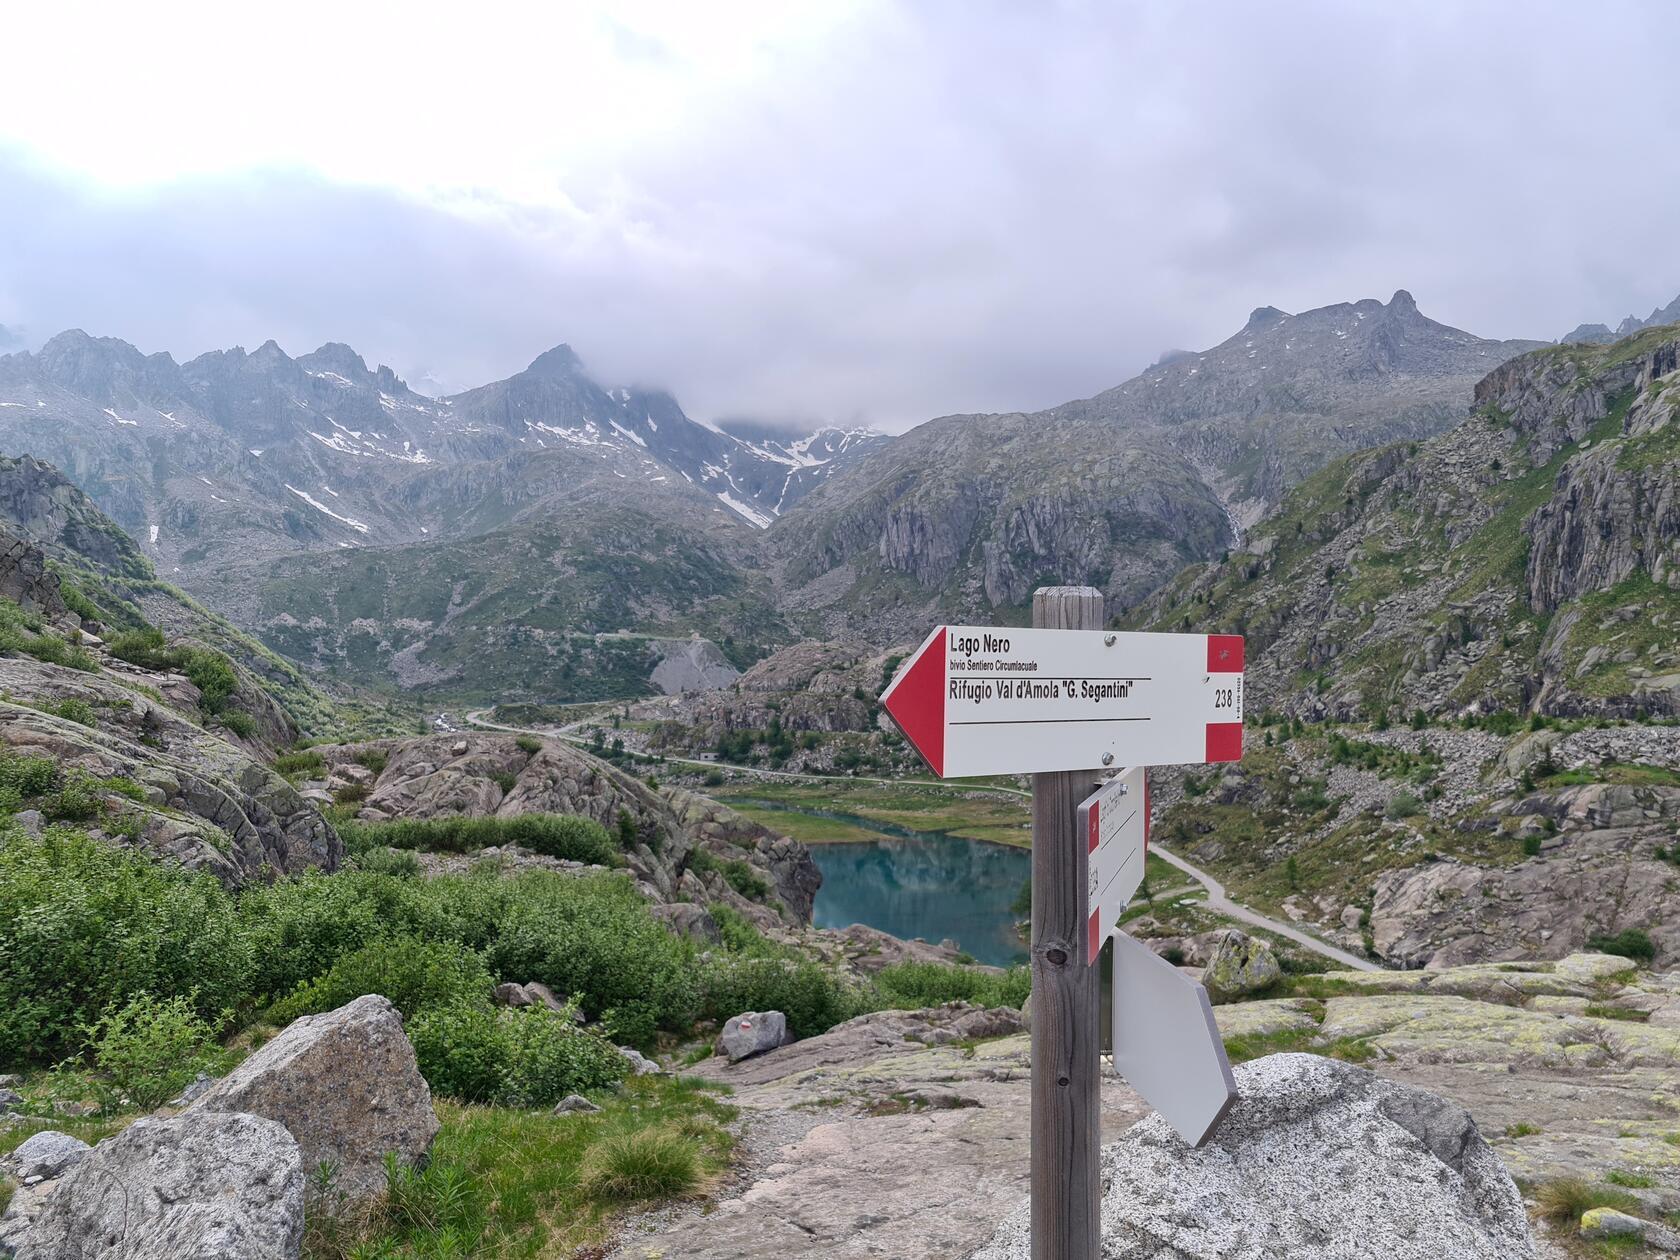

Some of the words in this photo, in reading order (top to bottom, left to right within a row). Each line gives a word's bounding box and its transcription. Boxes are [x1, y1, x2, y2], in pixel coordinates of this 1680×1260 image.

[950, 633, 980, 657] Lago
[983, 633, 1010, 653] Nero
[949, 659, 966, 671] bivio
[967, 659, 994, 671] Sentiero
[995, 660, 1038, 672] Circumlacuale
[949, 680, 992, 704] Rifugio
[996, 680, 1013, 699] Val
[1016, 680, 1059, 699] d'Amola
[1062, 680, 1078, 699] "G.
[1081, 680, 1133, 702] Segantini"
[1215, 689, 1232, 708] 238
